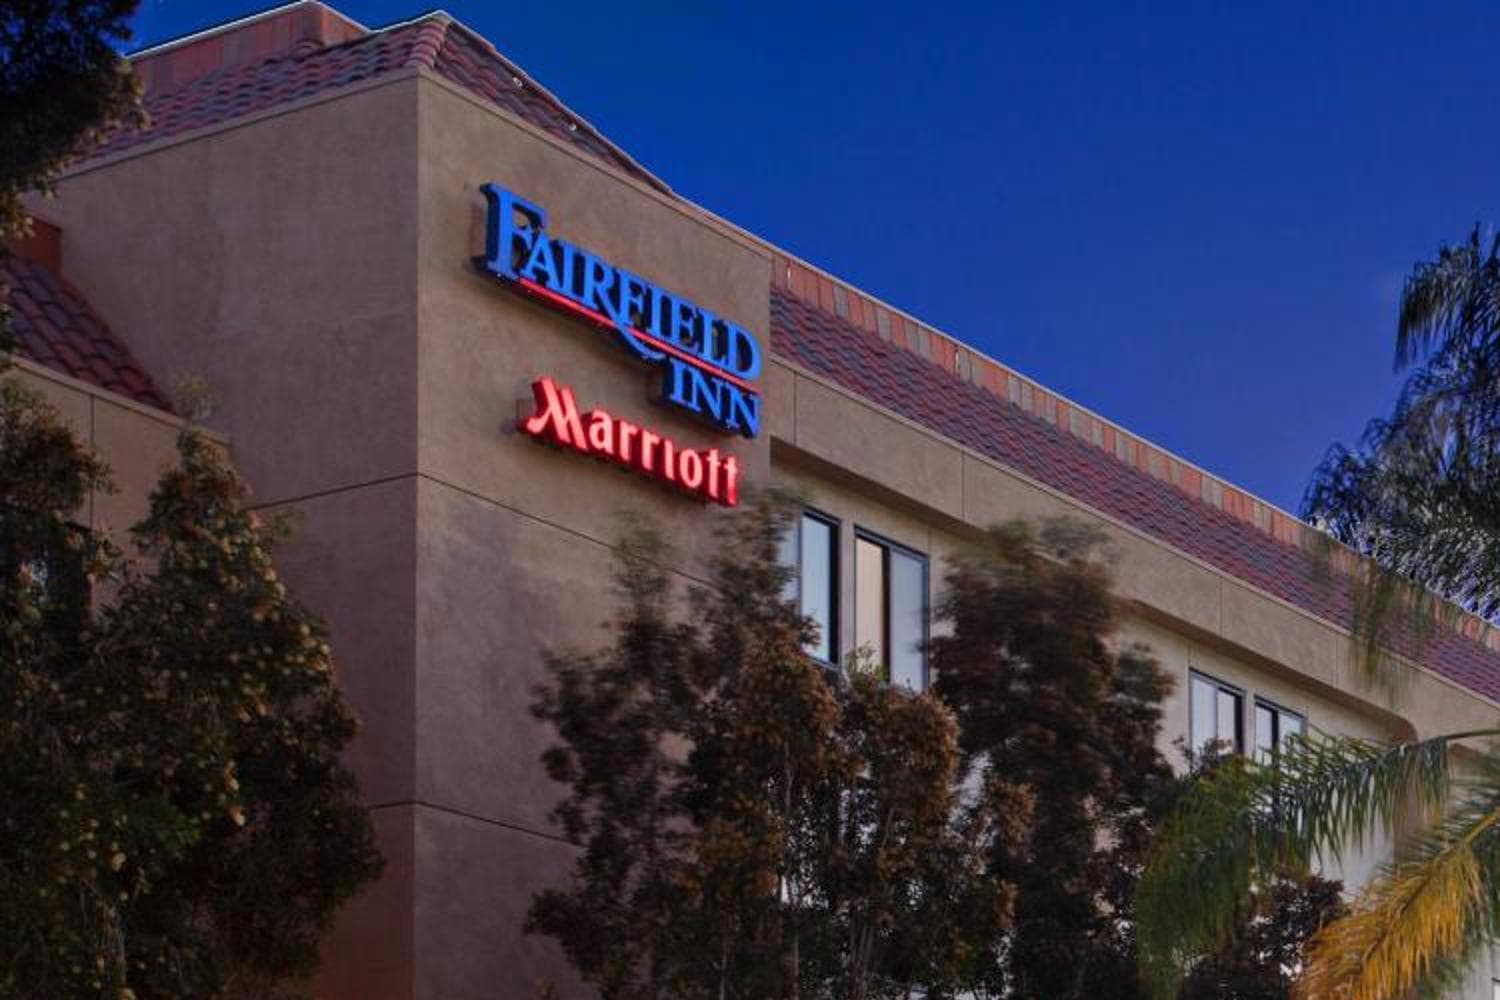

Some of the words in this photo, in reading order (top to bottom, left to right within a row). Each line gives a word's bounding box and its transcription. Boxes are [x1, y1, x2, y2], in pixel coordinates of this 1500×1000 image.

[479, 182, 764, 382] FAIRFIELD
[521, 376, 740, 507] Marriott
[666, 357, 764, 440] INN
